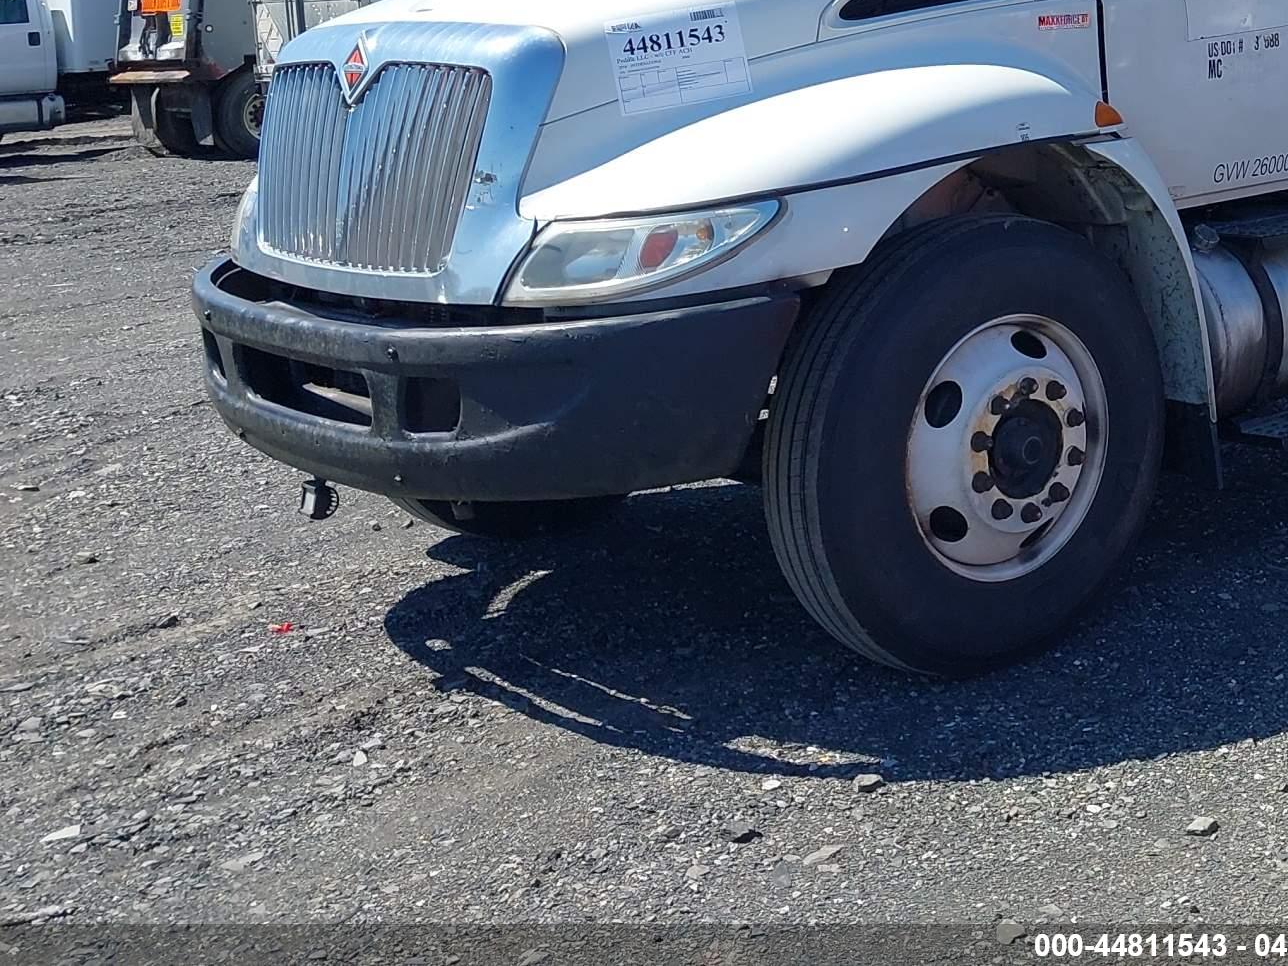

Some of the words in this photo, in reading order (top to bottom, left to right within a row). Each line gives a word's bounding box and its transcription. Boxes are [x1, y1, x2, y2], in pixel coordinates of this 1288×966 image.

[623, 24, 726, 55] 44811543
[1208, 41, 1219, 58] US
[1208, 59, 1223, 79] MC
[1214, 160, 1250, 183] GVW
